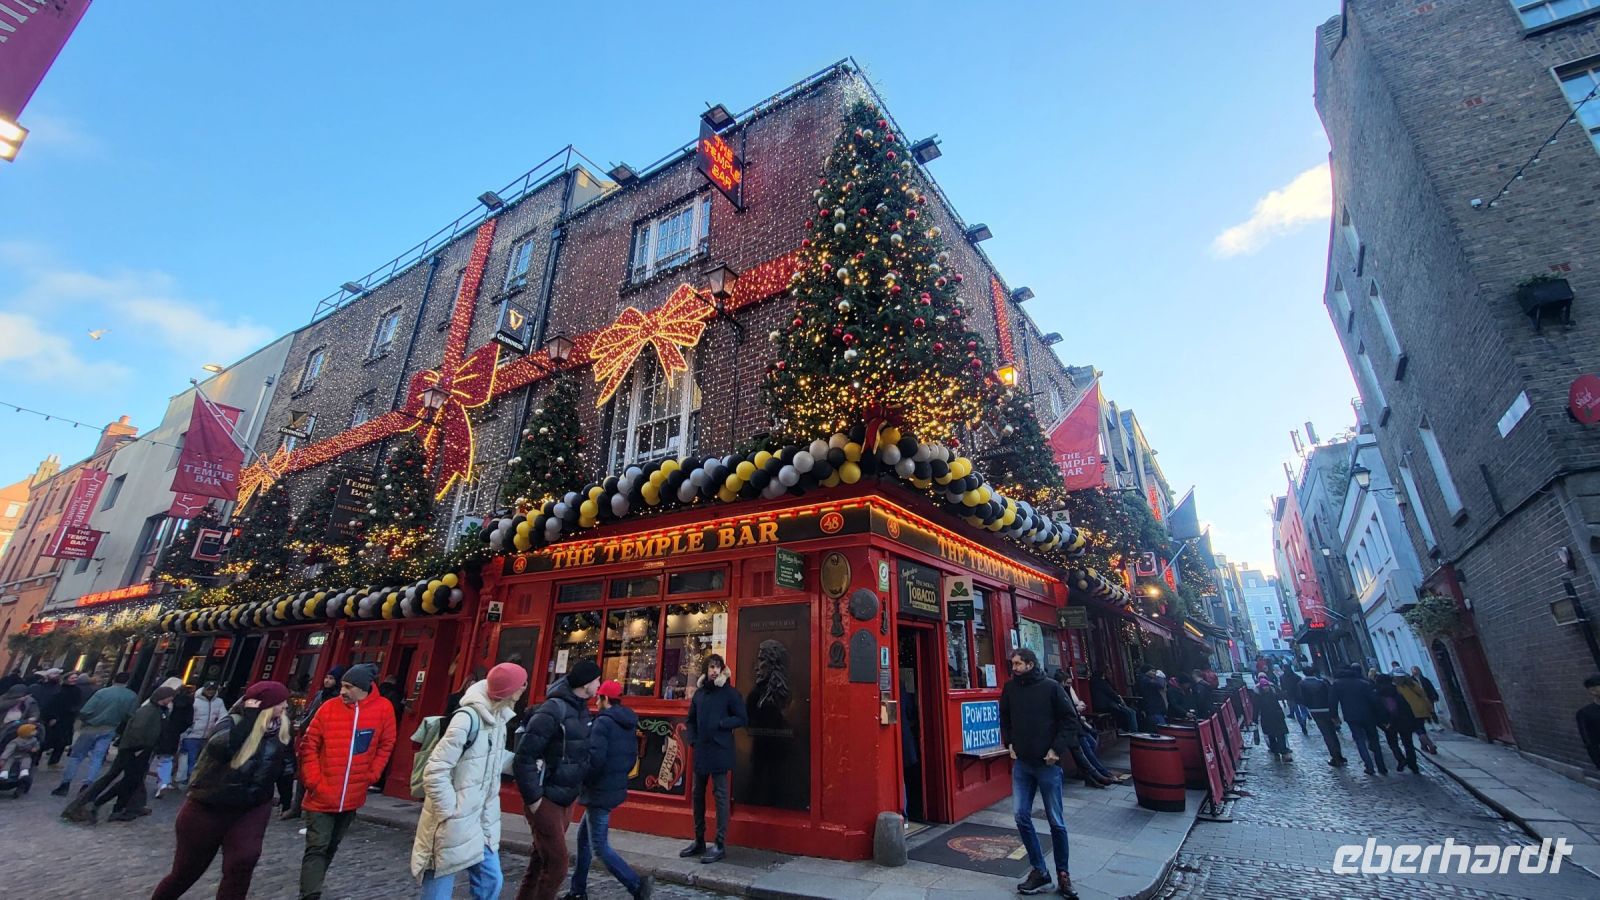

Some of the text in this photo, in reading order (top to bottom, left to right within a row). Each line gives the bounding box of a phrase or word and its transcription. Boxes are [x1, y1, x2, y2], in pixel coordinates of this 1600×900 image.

[713, 135, 733, 162] THE
[704, 140, 741, 183] TEMPLE
[712, 165, 732, 190] BAR
[202, 461, 223, 470] THE
[1051, 456, 1096, 469] EMPLE
[1061, 452, 1081, 461] THE
[184, 464, 234, 481] TEMPLE
[195, 475, 222, 487] BAR
[67, 533, 96, 542] TEMPLE
[552, 547, 596, 570] THE
[604, 532, 705, 562] TEMPLE
[718, 522, 780, 548] BAR
[823, 515, 841, 531] 48
[938, 536, 966, 563] THE
[968, 551, 1011, 582] TEMPLE
[1013, 566, 1031, 589] BAR
[906, 580, 936, 605] TOBACCO
[964, 728, 1000, 749] WHISKEY
